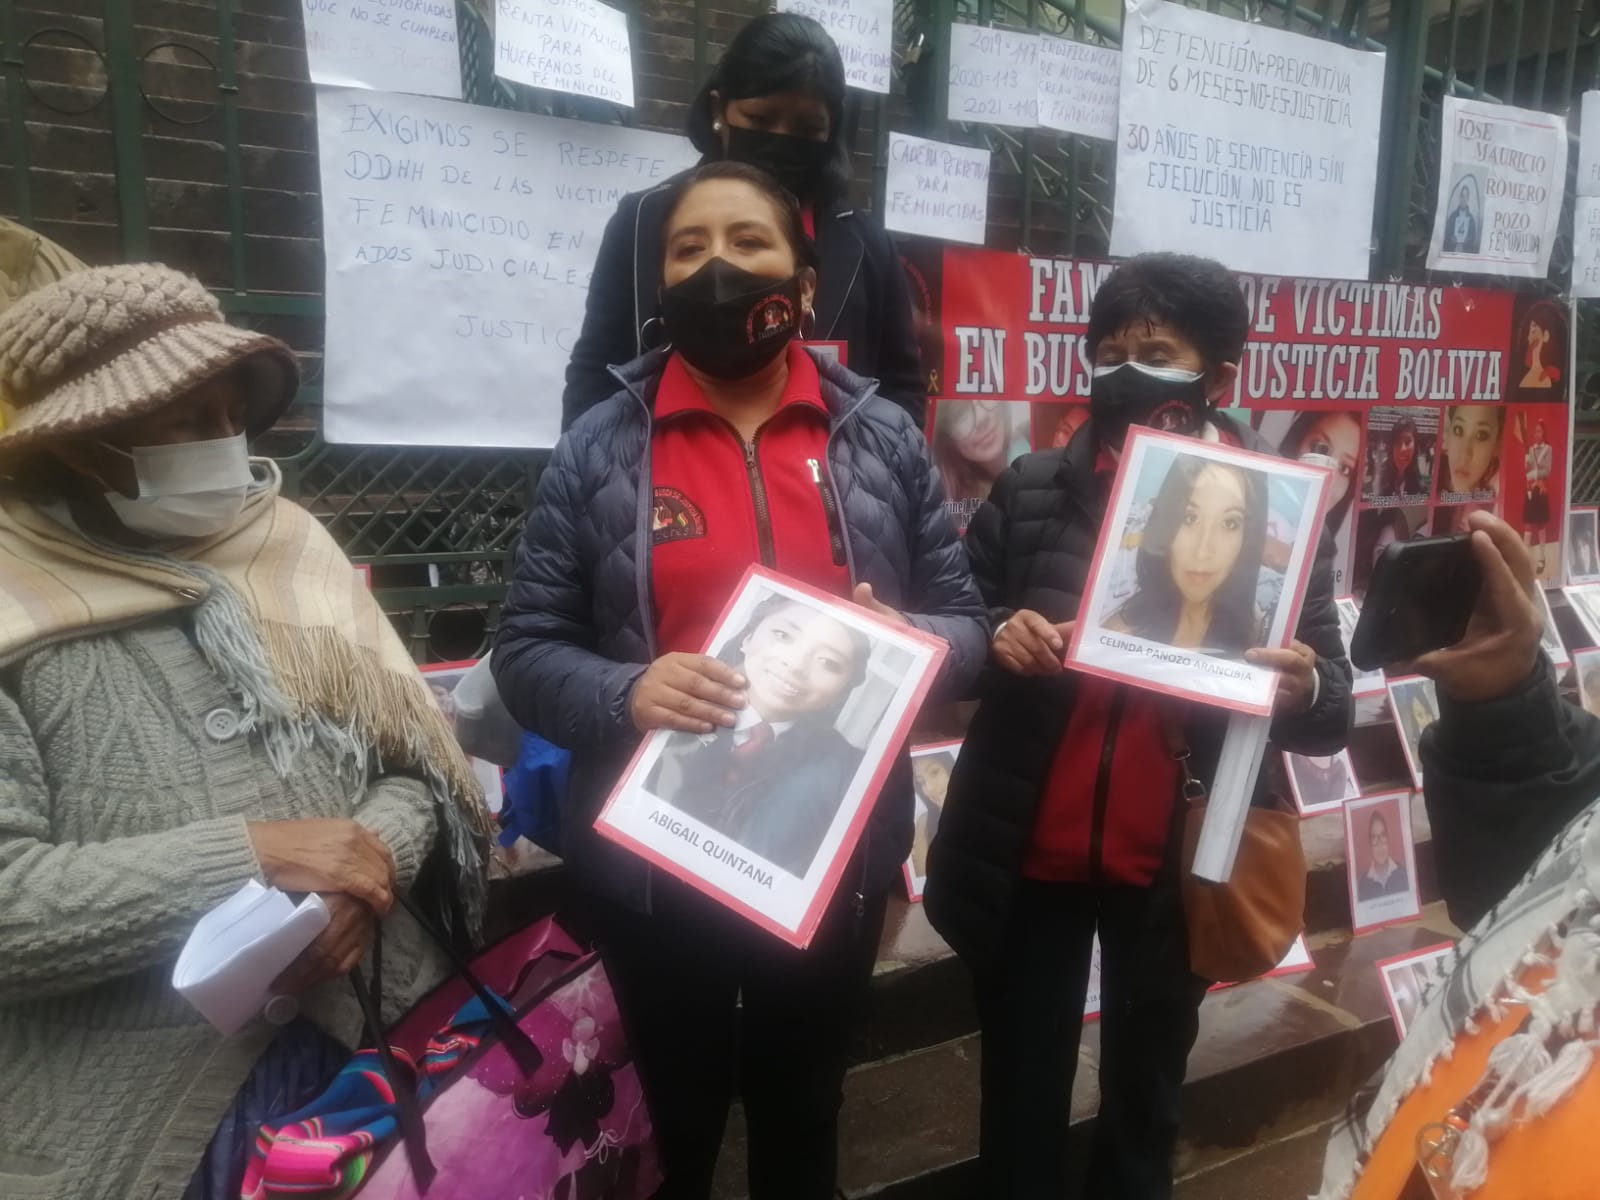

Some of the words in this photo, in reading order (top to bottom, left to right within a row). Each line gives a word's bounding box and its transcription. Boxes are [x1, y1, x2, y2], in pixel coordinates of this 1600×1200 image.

[350, 7, 369, 21] NO
[373, 12, 393, 26] SE
[500, 2, 554, 29] RENTA
[500, 40, 583, 76] HUERFANOS
[593, 66, 616, 84] DEL
[538, 34, 582, 56] PARA
[1137, 57, 1158, 88] DE
[1168, 64, 1179, 92] 6
[341, 103, 473, 148] EXIGIMOS
[492, 130, 530, 158] SE
[558, 140, 665, 179] RESPETE
[892, 140, 938, 168] CADENA
[1127, 123, 1150, 153] 30
[1152, 124, 1199, 161] AÑOS
[1206, 137, 1223, 165] DE
[1228, 141, 1313, 181] SENTENCIA
[1319, 154, 1345, 185] SIN
[1474, 142, 1546, 174] MAURICIO
[344, 150, 425, 183] DDHH
[440, 165, 473, 185] DE
[494, 175, 534, 196] LAS
[555, 184, 629, 204] VICTIM
[917, 175, 949, 194] PARA
[1147, 161, 1243, 201] EJECUCIÓN
[1251, 177, 1274, 204] NO
[1283, 181, 1303, 208] ES
[1485, 177, 1547, 206] ROMERO
[892, 191, 985, 222] FEMINICIDAS
[1190, 198, 1272, 233] JUSTICIA
[1494, 211, 1530, 231] POZO
[547, 230, 585, 251] EN
[1293, 278, 1444, 340] VICTIMAS
[954, 326, 1007, 393] EN
[1230, 340, 1380, 409] JUSTICIA
[1394, 346, 1503, 402] BOLIVIA
[1099, 635, 1143, 655] CELINDA
[1146, 647, 1191, 666] PANOZO
[1192, 659, 1252, 680] ARANCIBIA
[648, 810, 700, 848] ABIGAIL
[702, 839, 775, 890] QUINTANA
